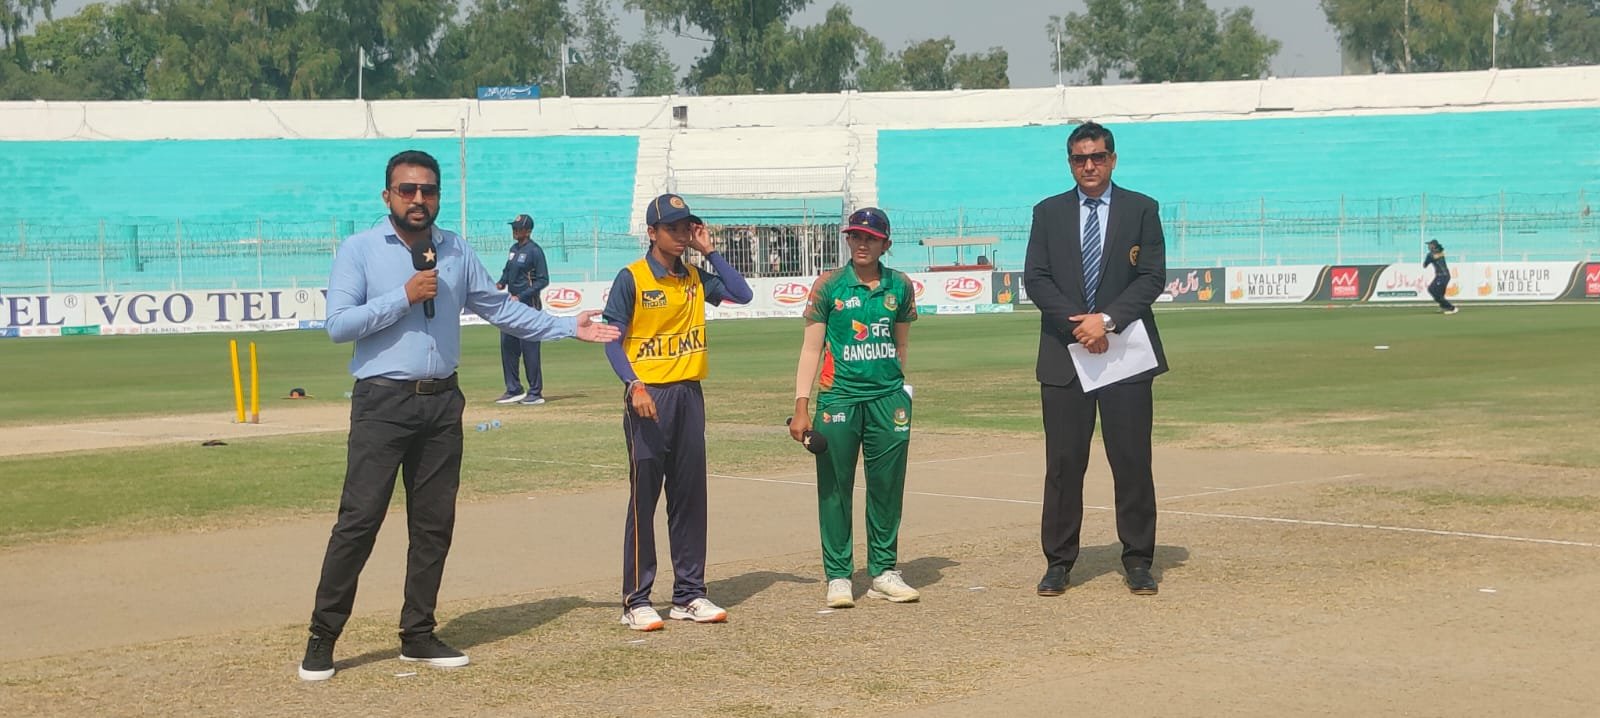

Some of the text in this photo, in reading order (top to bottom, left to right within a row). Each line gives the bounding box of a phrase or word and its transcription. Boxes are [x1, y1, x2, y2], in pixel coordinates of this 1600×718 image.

[1247, 272, 1297, 285] LYALLPUR
[1497, 269, 1550, 281] LYALLPUR
[1248, 284, 1289, 296] MODEL
[1497, 280, 1542, 292] MODEL
[95, 293, 194, 325] VGO
